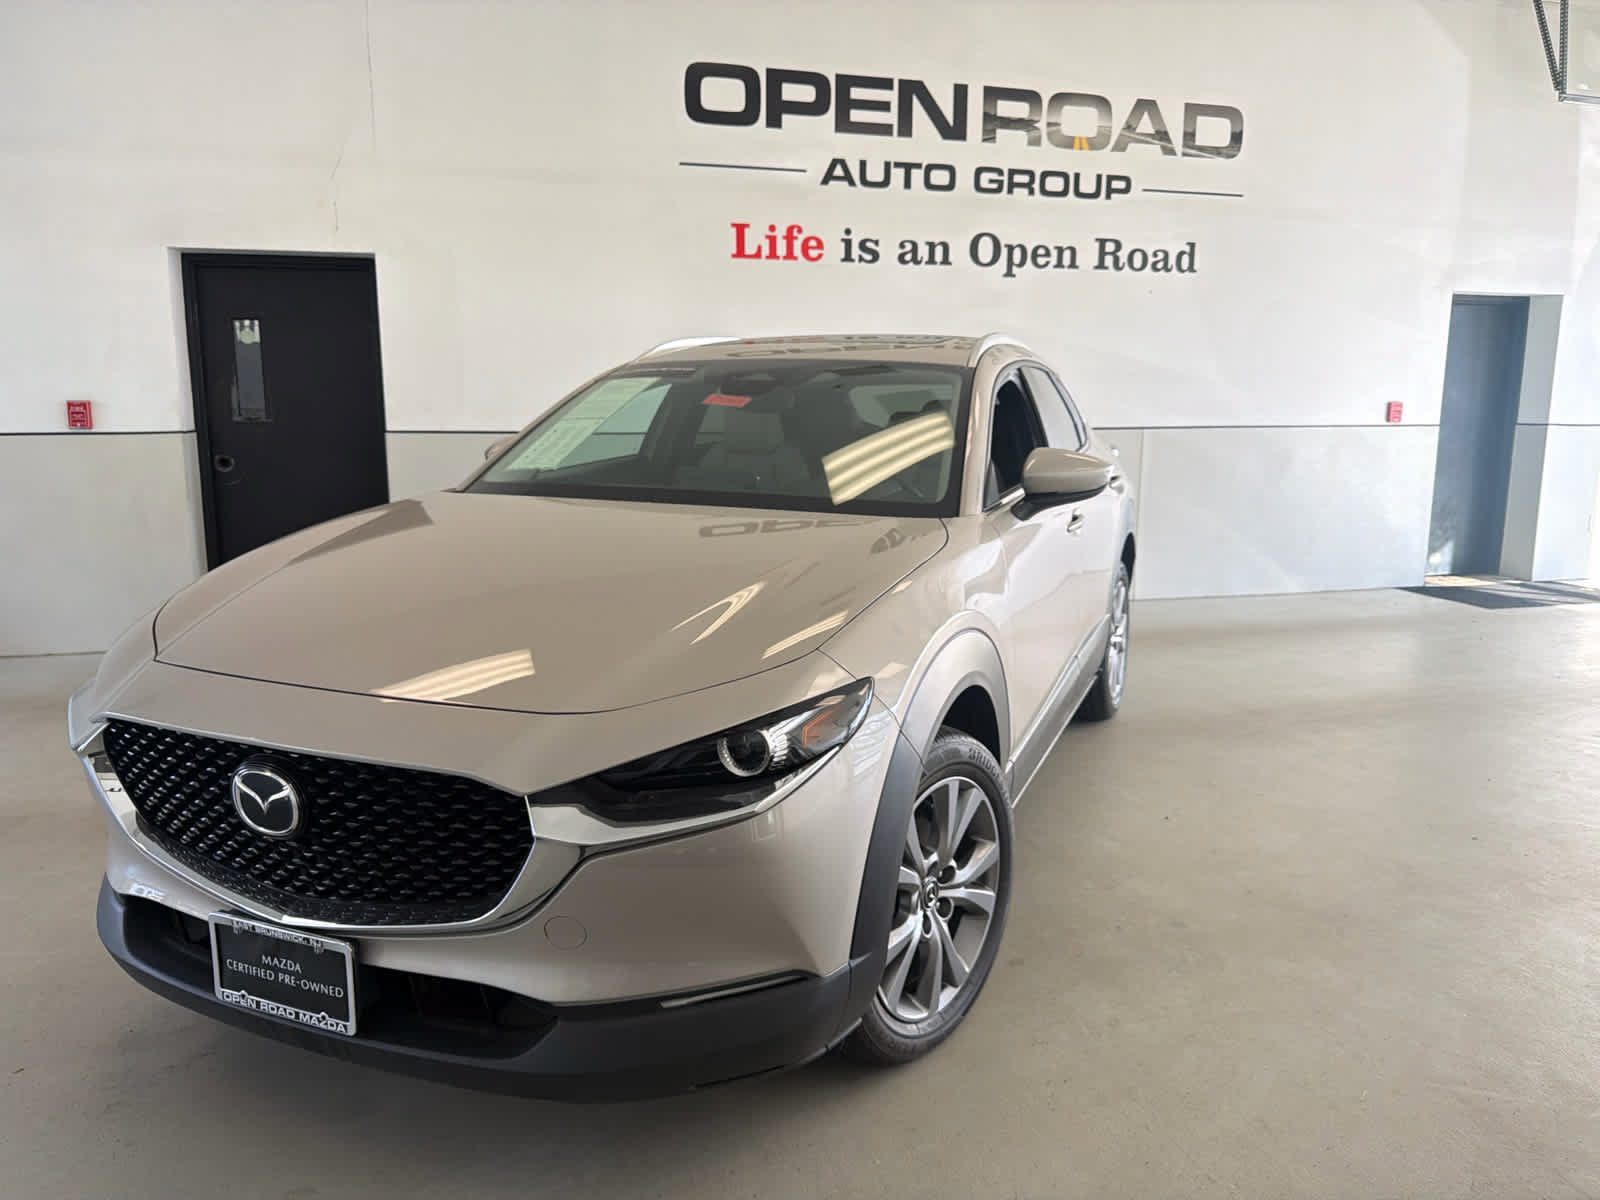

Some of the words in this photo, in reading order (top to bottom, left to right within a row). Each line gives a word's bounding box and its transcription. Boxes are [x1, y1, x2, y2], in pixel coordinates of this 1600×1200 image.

[684, 62, 968, 142] OPEN
[982, 85, 1244, 160] ROAD
[820, 158, 957, 193] AUTO
[974, 166, 1133, 200] GROUP
[731, 223, 824, 262] Life
[840, 227, 881, 264] is
[897, 239, 952, 266] an
[969, 232, 1079, 278] Open
[1093, 238, 1198, 273] Road
[226, 958, 275, 981] CERTIFIED
[278, 972, 344, 998] PRE-OWNED
[262, 954, 302, 974] MAZDA
[224, 992, 257, 1009] OPEN
[260, 1002, 296, 1019] ROAD
[299, 1013, 347, 1033] MAZDA
